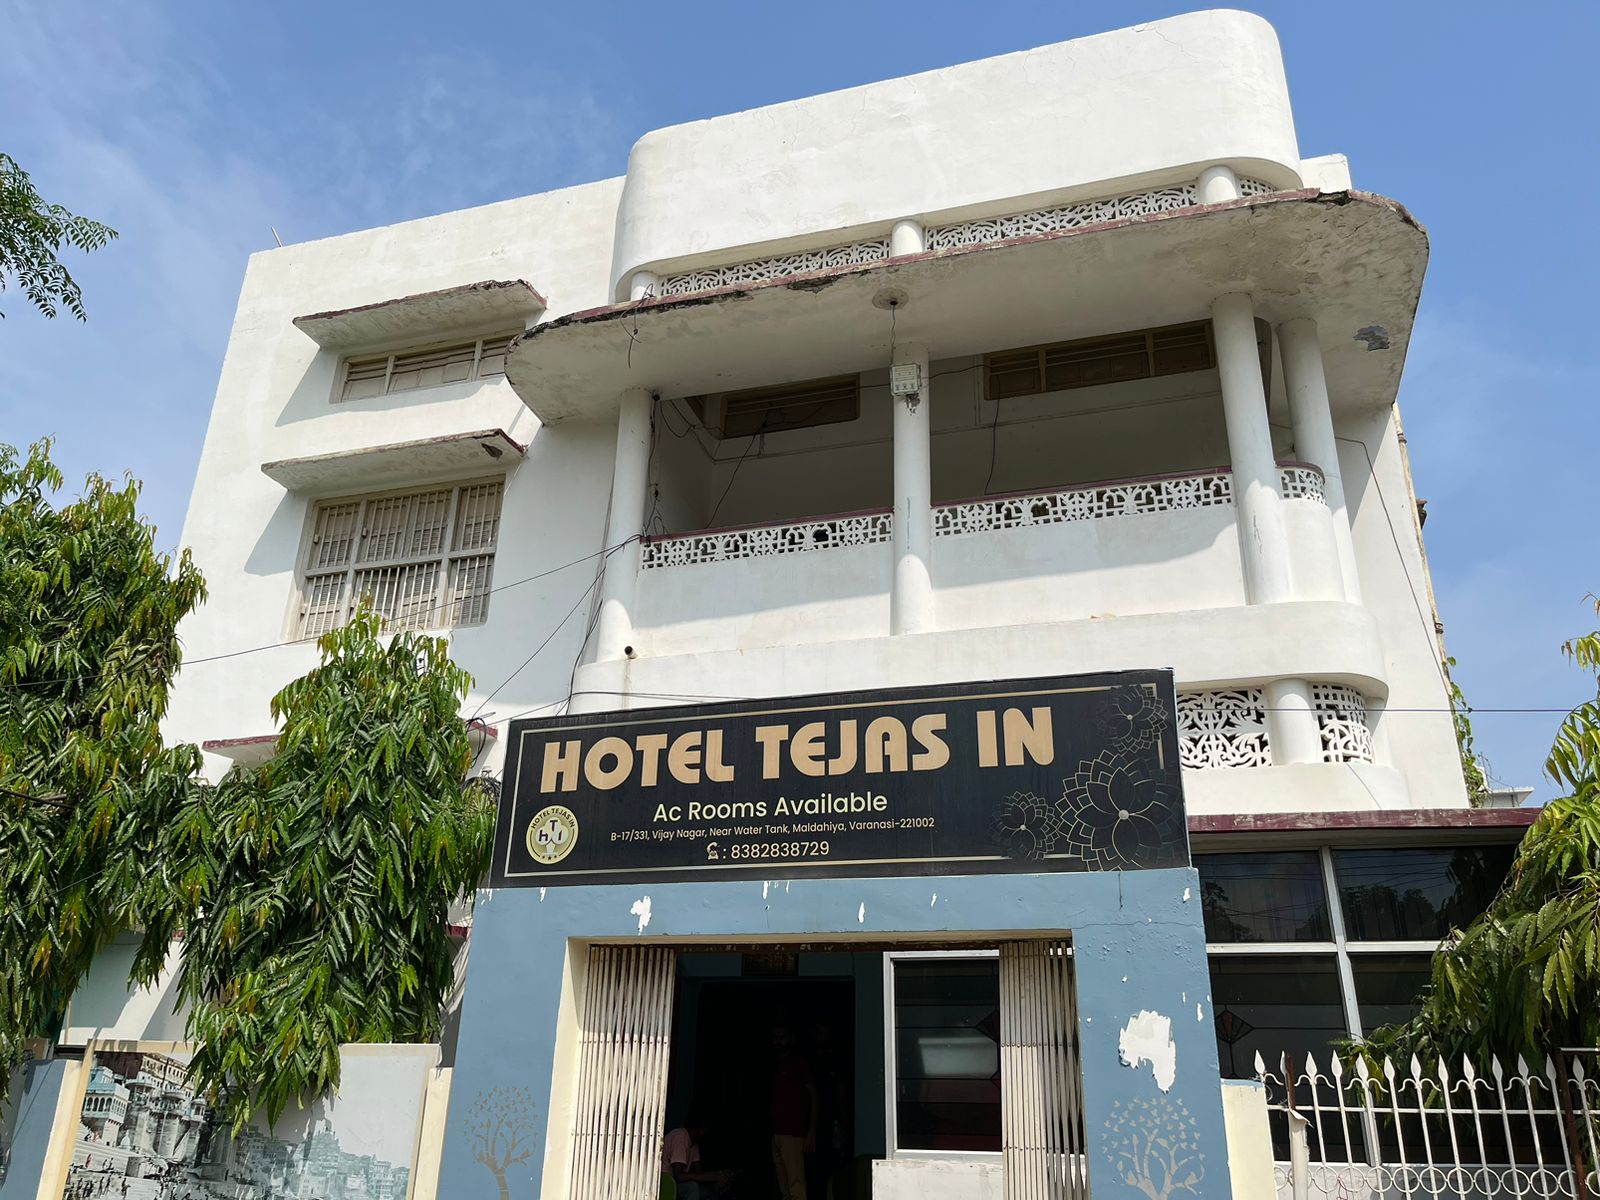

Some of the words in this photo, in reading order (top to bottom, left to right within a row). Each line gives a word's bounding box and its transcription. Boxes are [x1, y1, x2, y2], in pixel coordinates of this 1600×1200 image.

[539, 729, 735, 794] HOTEL
[755, 713, 950, 780] TEJAS
[976, 705, 1055, 768] IN
[531, 810, 550, 829] HOTEL
[551, 807, 571, 820] TEJAS
[568, 818, 576, 828] IN
[652, 803, 682, 823] Ac
[688, 801, 767, 821] Rooms
[773, 791, 888, 817] Available
[610, 829, 650, 843] B-17/331,
[651, 828, 675, 842] Vijay
[676, 827, 708, 839] Nagar,
[709, 827, 732, 837] Near
[734, 825, 763, 837] Water
[764, 825, 789, 836] Tank,
[792, 821, 848, 835] Maldahiya,
[849, 817, 935, 830] Varanasi-221002
[730, 840, 830, 860] 8382838729
